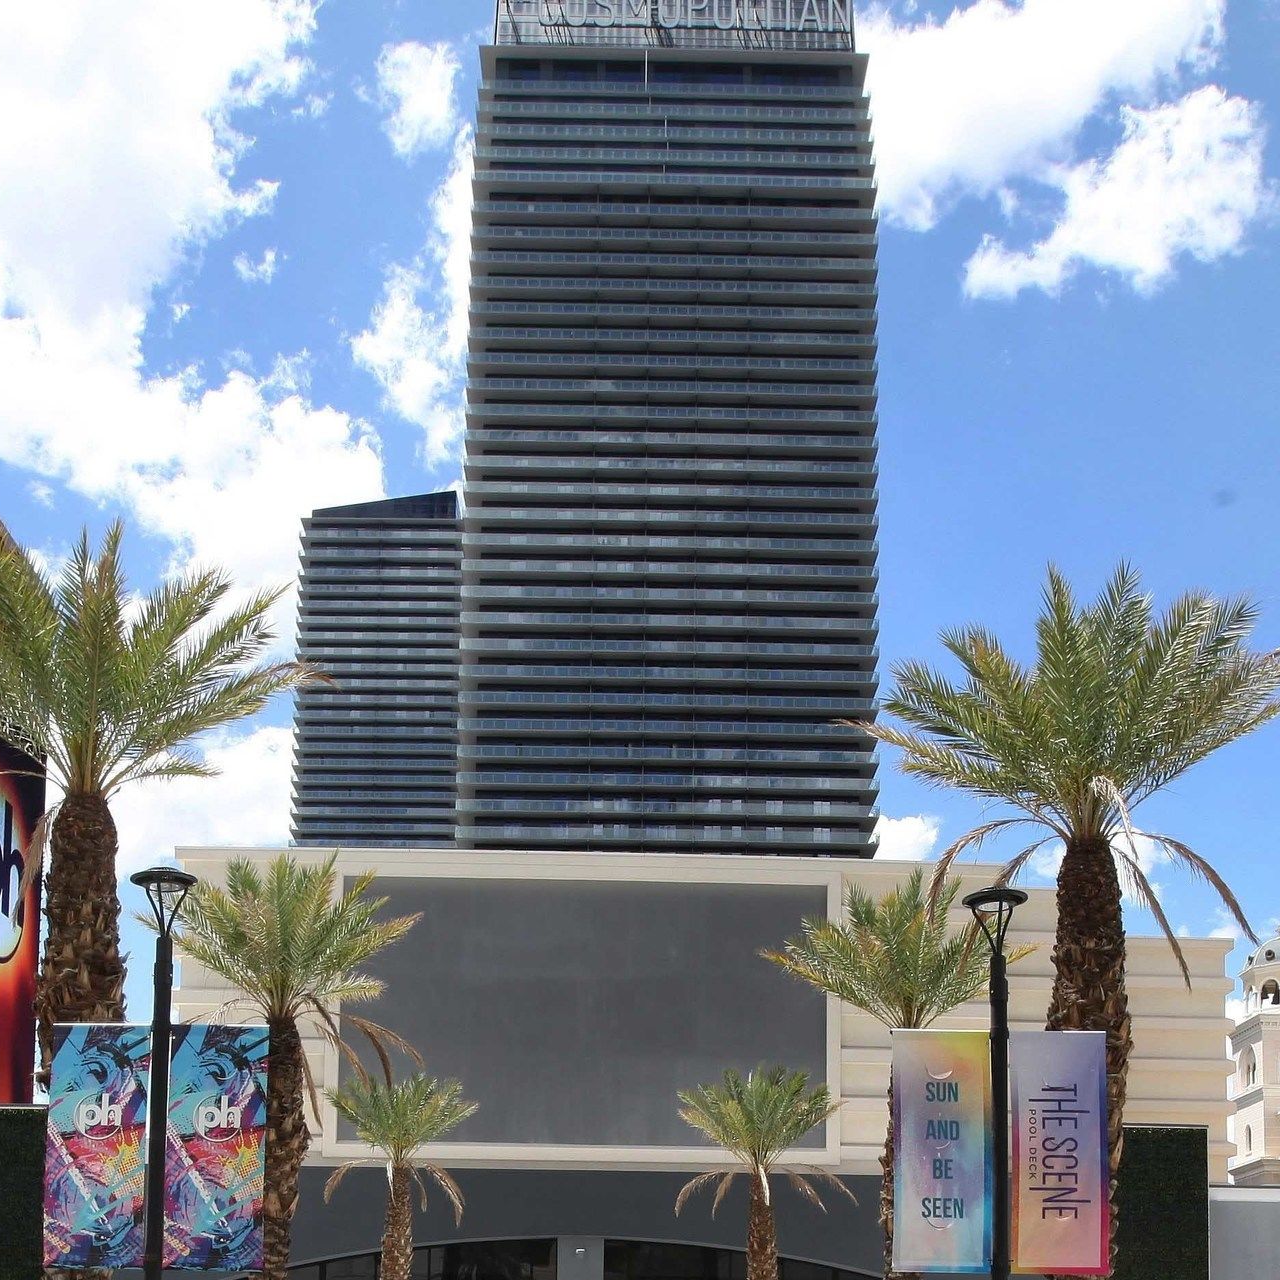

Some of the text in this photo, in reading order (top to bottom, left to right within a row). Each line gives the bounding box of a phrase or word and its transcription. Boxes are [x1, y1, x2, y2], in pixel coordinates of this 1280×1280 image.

[925, 1081, 959, 1103] SUN
[925, 1120, 960, 1141] AND
[1028, 1108, 1037, 1180] POOL DECK
[1028, 1083, 1091, 1220] THE SCENE
[932, 1158, 954, 1180] BE
[921, 1197, 964, 1219] SEEN
